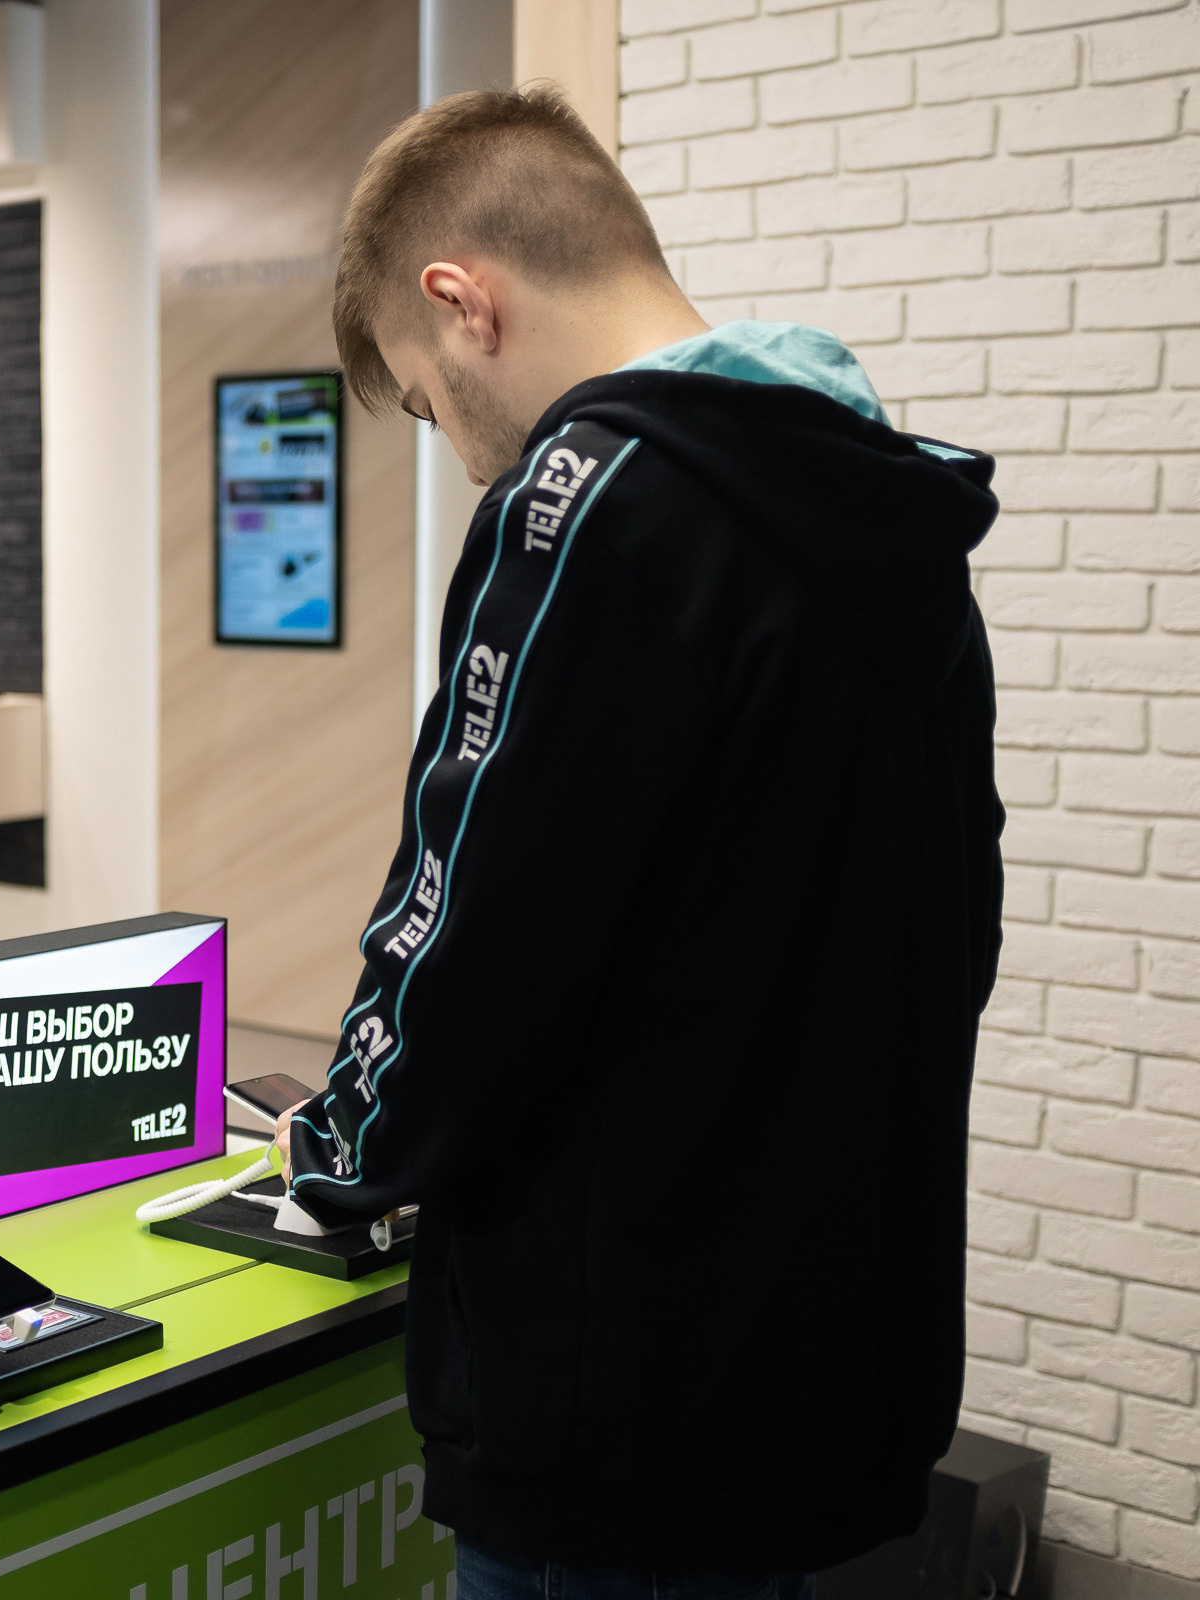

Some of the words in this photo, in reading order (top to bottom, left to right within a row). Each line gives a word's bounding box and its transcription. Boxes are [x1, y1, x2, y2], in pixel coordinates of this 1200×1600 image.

[524, 448, 599, 552] TELE2
[457, 644, 509, 761] TELE2
[383, 849, 443, 960] TELE2
[26, 1001, 135, 1045] ВЫБОР
[70, 1033, 191, 1079] ПОЛЬЗУ
[131, 1102, 187, 1142] TELE2
[130, 1463, 456, 1600] ЕНТР
